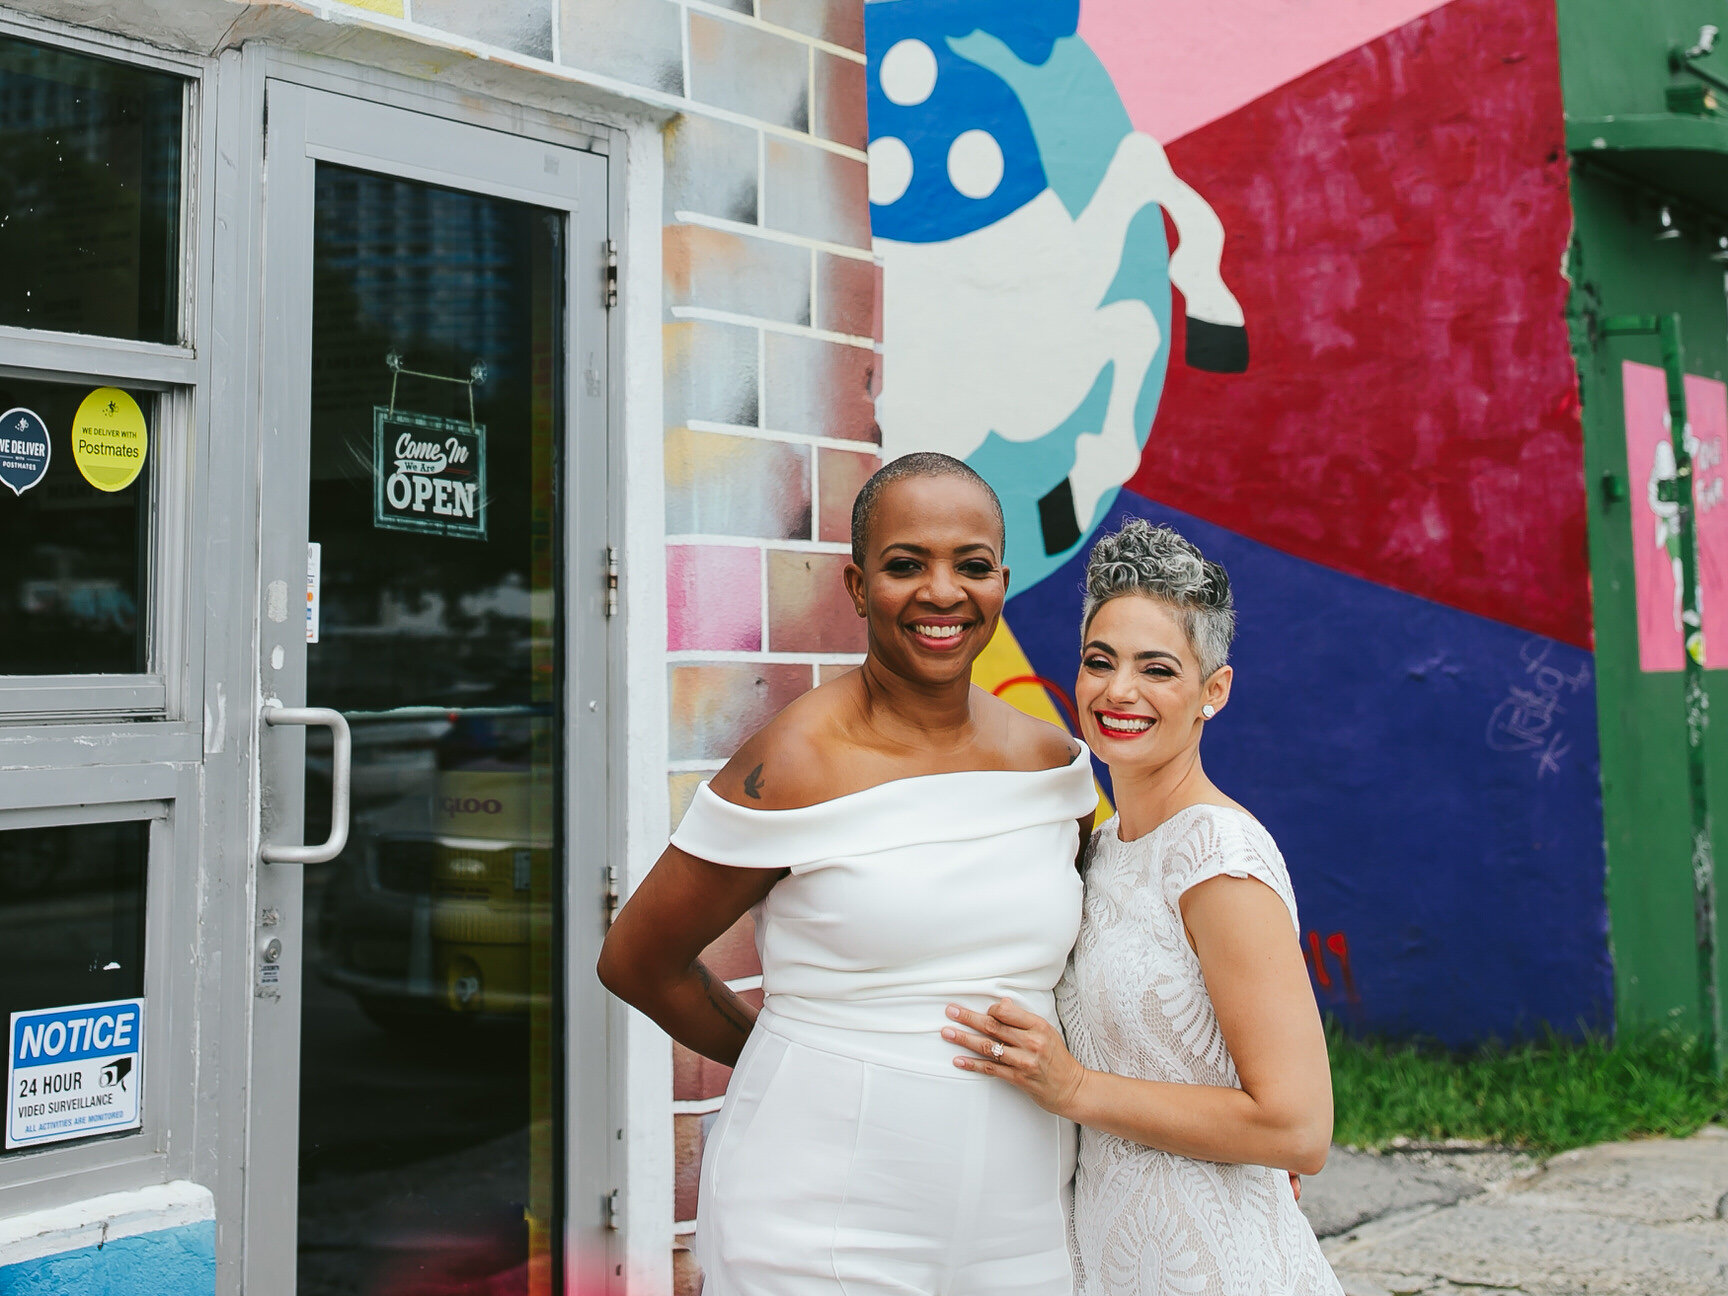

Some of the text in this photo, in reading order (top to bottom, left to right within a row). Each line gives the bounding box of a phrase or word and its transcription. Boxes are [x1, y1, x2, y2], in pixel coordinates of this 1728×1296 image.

[82, 427, 137, 439] WE DELIVER WITH
[11, 439, 45, 457] DELIVER
[79, 439, 139, 458] Postmates
[395, 433, 470, 464] Come In
[3, 460, 36, 471] POSTMATES
[404, 461, 435, 472] We Are
[387, 472, 478, 518] OPEN
[19, 1012, 135, 1060] NOTICE
[20, 1071, 82, 1098] 24 HOUR
[18, 1093, 113, 1118] VIDEO SURVEILLANCE
[25, 1125, 37, 1133] ALL
[39, 1119, 72, 1130] ACTIVITIES
[74, 1116, 86, 1125] ARE
